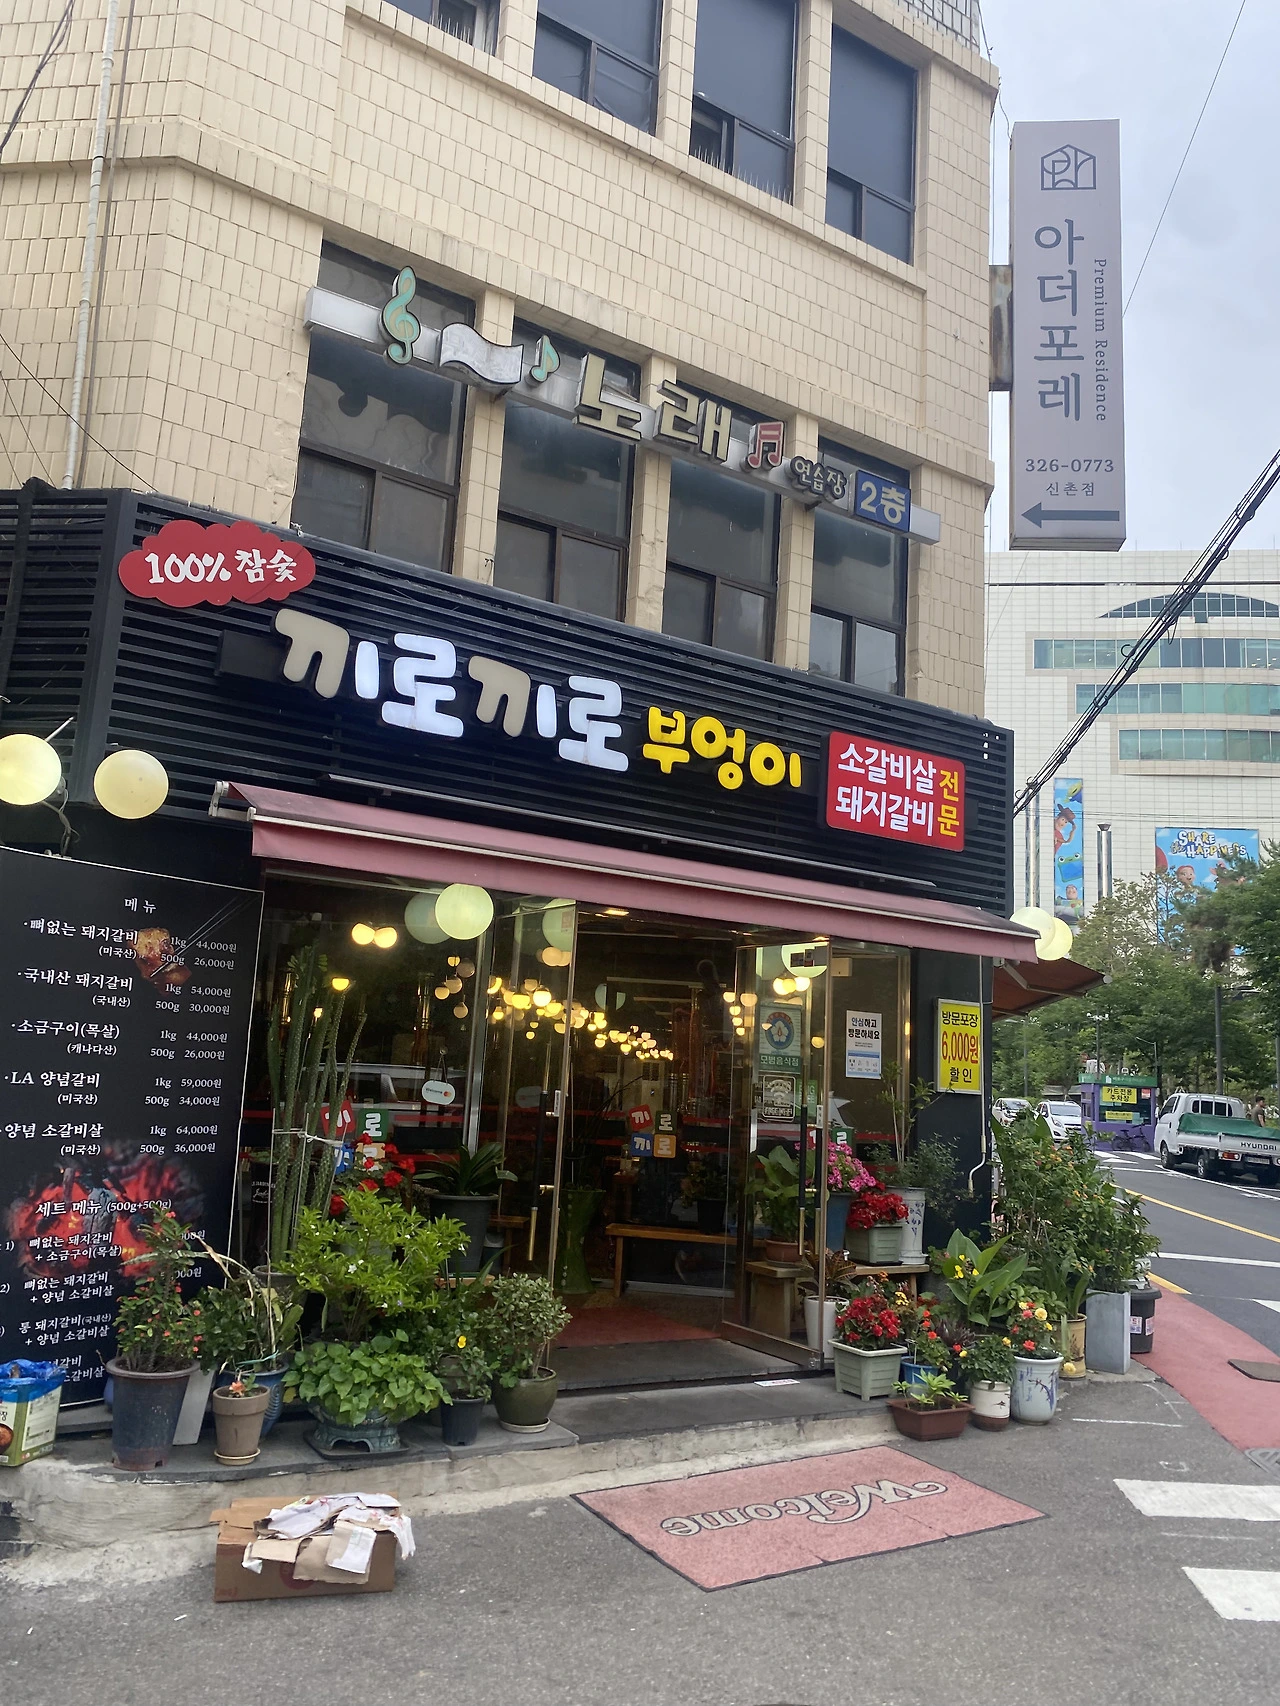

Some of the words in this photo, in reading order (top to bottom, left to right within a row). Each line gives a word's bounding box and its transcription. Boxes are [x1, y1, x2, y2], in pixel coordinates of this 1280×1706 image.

[1095, 259, 1108, 333] Premium
[1034, 218, 1084, 421] 아더포레
[1095, 339, 1109, 421] Residence
[573, 352, 732, 464] 노래
[1025, 458, 1114, 473] 326-0773
[791, 456, 847, 500] 연습장
[1046, 481, 1095, 497] 신촌점
[860, 480, 906, 524] 2층
[145, 552, 232, 584] 100%
[234, 549, 298, 583] 참숯
[275, 608, 629, 772] 끼로끼로
[642, 706, 803, 790] 부엉이
[838, 742, 937, 796] 소갈비살
[835, 785, 934, 837] 돼지갈비
[938, 769, 960, 837] 전문
[1178, 830, 1216, 846] SHARE
[81, 925, 139, 945] 돼지갈비
[98, 946, 138, 959] (미국산)
[170, 937, 187, 949] 1kg
[195, 940, 237, 953] 44,000원
[160, 954, 185, 966] 500g
[194, 957, 235, 970] 26,000원
[24, 968, 71, 987] 국내산
[75, 973, 134, 992] 돼지갈비
[165, 984, 182, 995] 1kg
[190, 986, 232, 998] 54,000원
[92, 995, 131, 1008] (국내산)
[155, 1000, 180, 1013] 500g
[188, 1003, 230, 1015] 30,000원
[851, 1017, 877, 1028] 안심하고
[942, 1010, 979, 1028] 방문포장
[17, 1019, 121, 1039] 소금구이(목살)
[160, 1030, 177, 1041] 1kg
[186, 1032, 228, 1044] 44,000원
[848, 1028, 880, 1040] 방문하세요
[67, 1044, 118, 1056] (캐나다산)
[150, 1048, 175, 1060] 500g
[184, 1049, 226, 1061] 26,000원
[941, 1031, 979, 1065] 6,000원
[760, 1055, 799, 1067] 모범음식점
[10, 1071, 34, 1085] LA
[40, 1070, 101, 1088] 양념갈비
[154, 1077, 172, 1089] 1kg
[180, 1078, 222, 1089] 59,000원
[57, 1093, 98, 1106] (미국산)
[144, 1095, 170, 1107] 500g
[178, 1096, 220, 1107] 34,000원
[5, 1123, 36, 1139] 양념
[41, 1122, 104, 1139] 소갈비살
[149, 1124, 167, 1136] 1kg
[176, 1124, 218, 1136] 64,000원
[60, 1142, 101, 1156] (미국산)
[139, 1142, 165, 1155] 500g
[173, 1142, 216, 1154] 36,000원
[1240, 1141, 1277, 1151] HYUNDAI
[35, 1201, 67, 1215] 세트
[72, 1200, 102, 1214] 메뉴
[68, 1231, 113, 1246] 돼지갈비
[63, 1271, 109, 1286] 돼지갈비
[42, 1290, 65, 1304] 양념
[68, 1284, 115, 1300] 소갈비살
[36, 1332, 60, 1346] 양념
[63, 1325, 110, 1342] 소갈비살
[660, 1479, 948, 1537] Welcome
